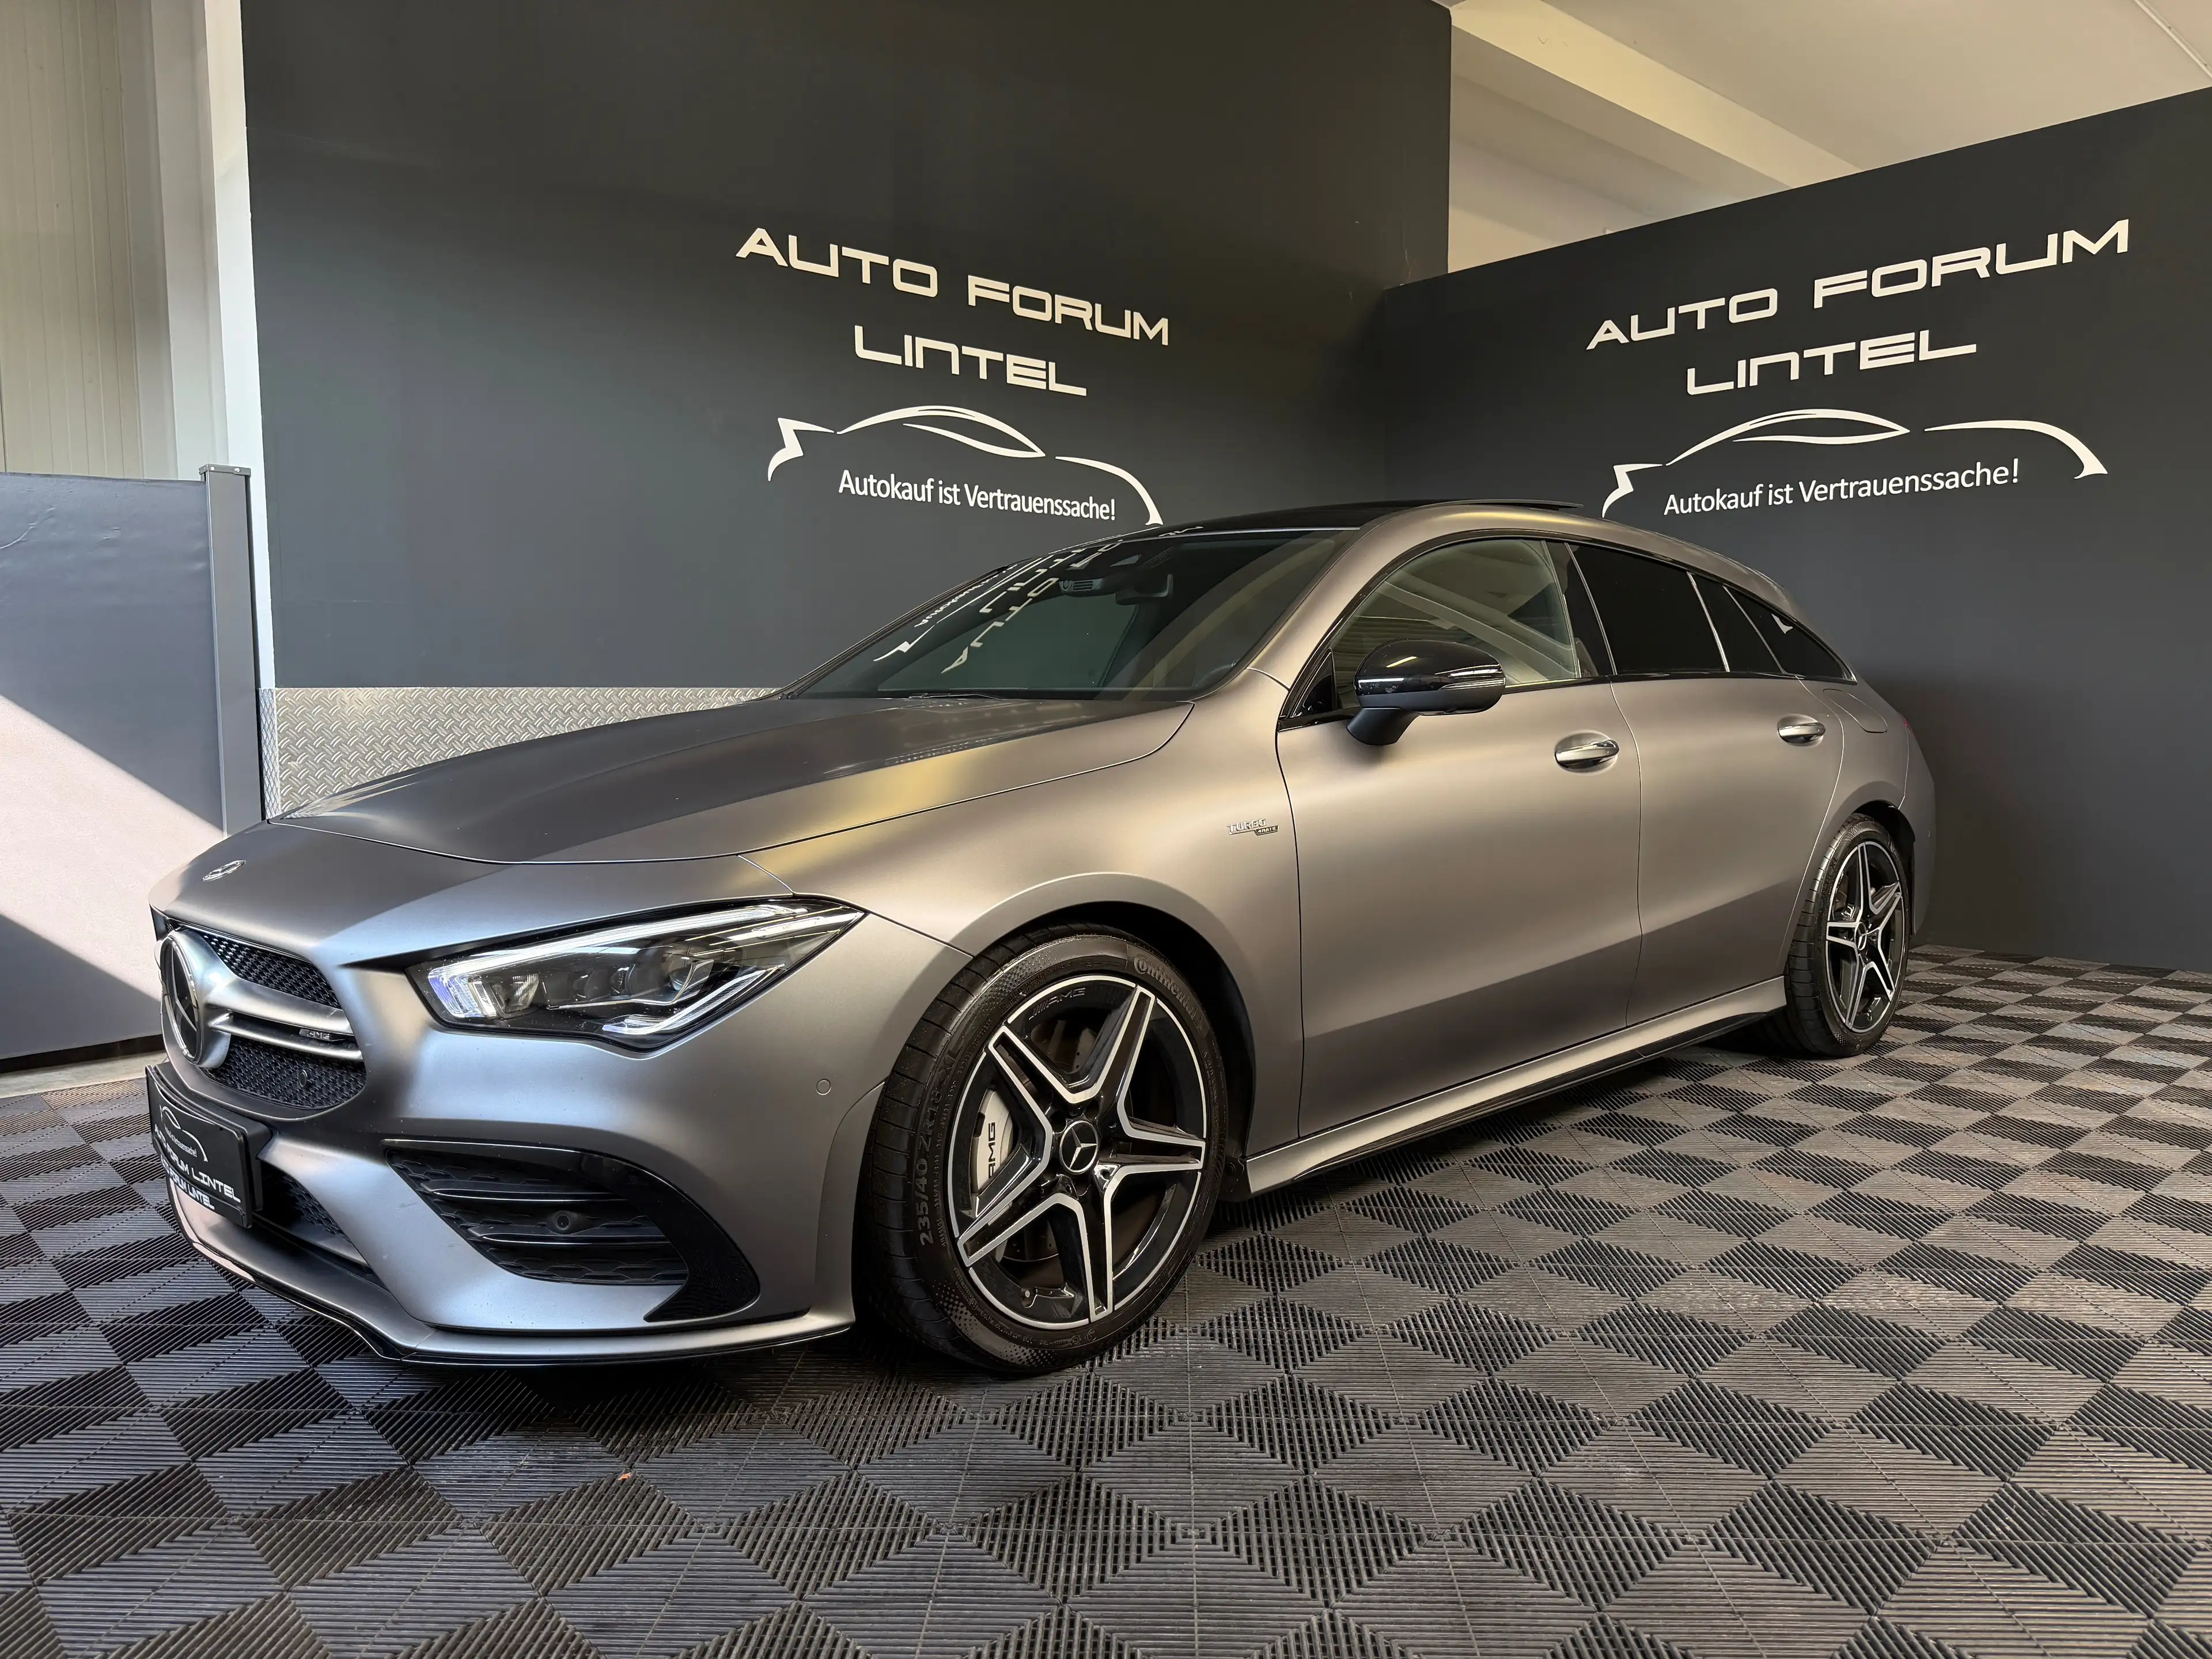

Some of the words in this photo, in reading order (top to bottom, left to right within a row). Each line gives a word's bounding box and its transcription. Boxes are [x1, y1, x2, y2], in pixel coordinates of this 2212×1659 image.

[736, 228, 938, 297] AUTO
[968, 275, 1168, 346] FORUM
[1586, 288, 1778, 350] AUTO
[1813, 219, 2129, 309] FORUM
[854, 325, 1087, 396] LINTEL
[1687, 329, 1977, 395] LINTEL
[838, 469, 934, 502] Autokauf
[938, 479, 961, 506] ist
[964, 483, 1116, 521] Vertrauenssache!
[1664, 483, 1764, 516] Autokauf
[1767, 483, 1794, 506] ist
[1798, 458, 2020, 502] Vertrauenssache!
[1227, 818, 1266, 833] TURBO
[1133, 954, 1196, 1021] Continental
[187, 1184, 215, 1210] LINTEL
[191, 1167, 241, 1203] LINTEL
[914, 1157, 933, 1246] 235/40
